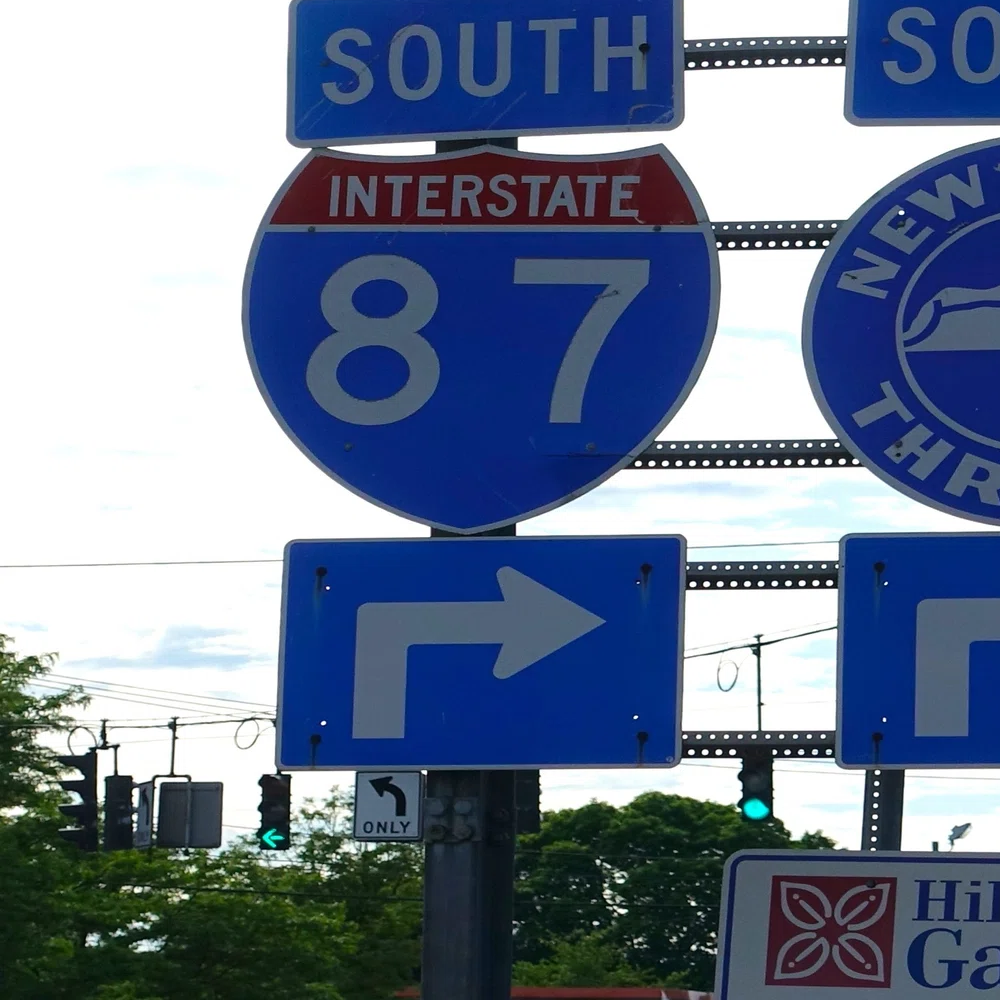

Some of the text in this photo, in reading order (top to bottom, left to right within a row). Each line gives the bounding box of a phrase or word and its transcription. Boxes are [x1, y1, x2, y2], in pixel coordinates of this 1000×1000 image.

[321, 15, 647, 105] SOUTH
[328, 175, 641, 218] INTERSTATE
[837, 164, 986, 300] NEW
[306, 254, 651, 426] 87
[363, 821, 410, 834] ONLY
